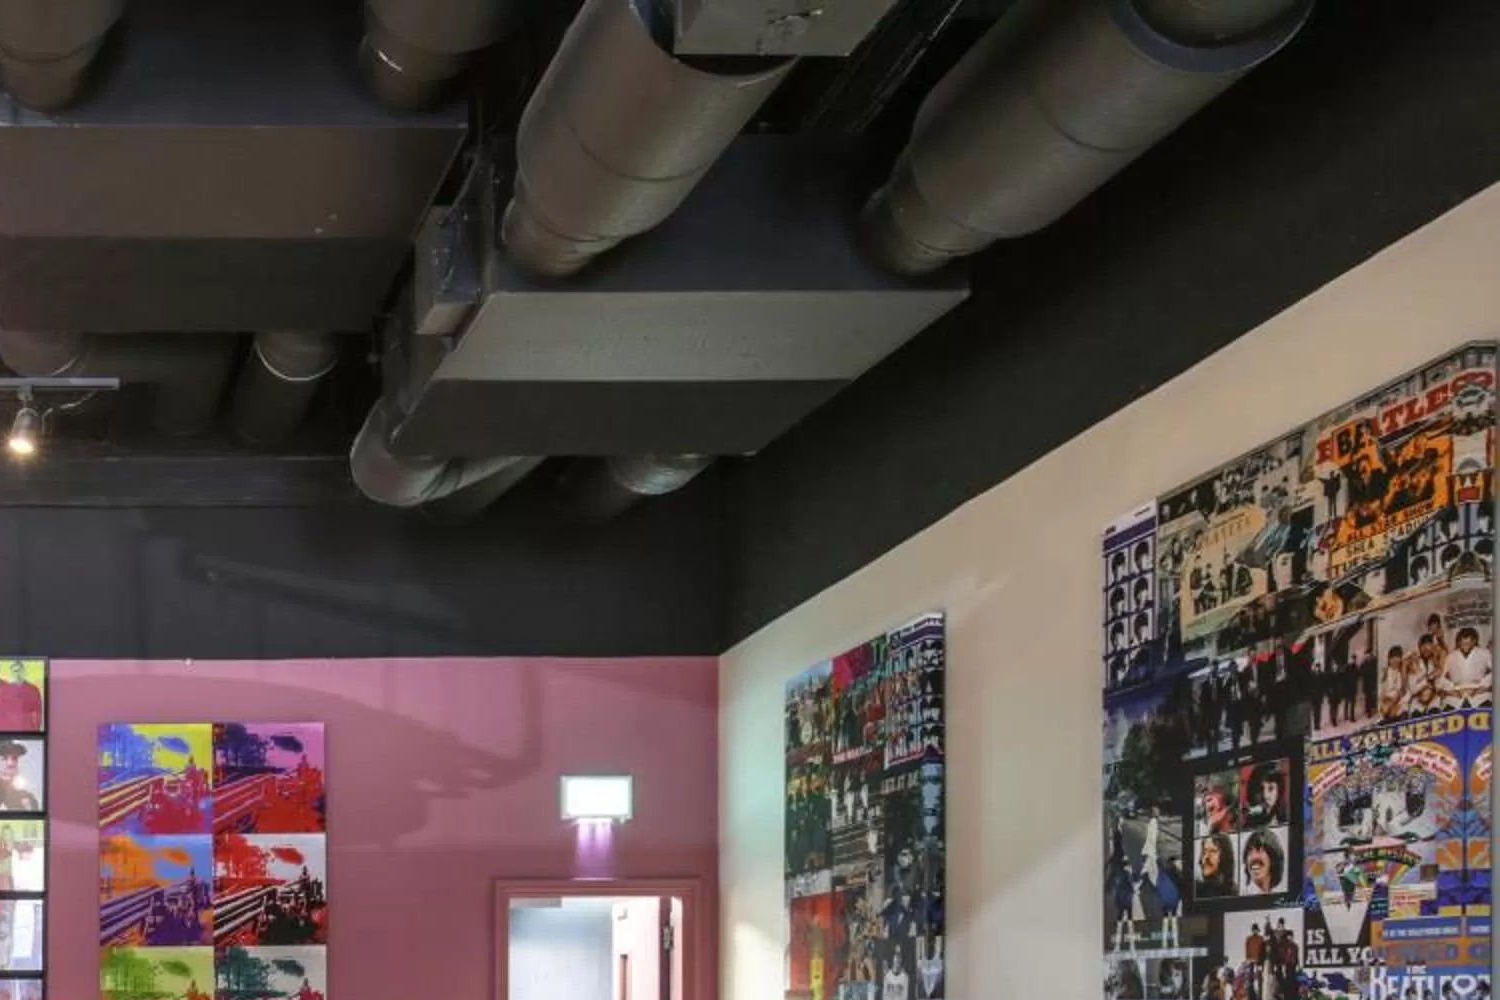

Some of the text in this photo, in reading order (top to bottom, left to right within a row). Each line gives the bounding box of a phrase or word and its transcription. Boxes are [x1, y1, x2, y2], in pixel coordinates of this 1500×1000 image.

[1350, 728, 1394, 749] YOU
[1399, 714, 1465, 742] NEED
[1306, 929, 1326, 945] IS
[1305, 947, 1344, 966] ALL
